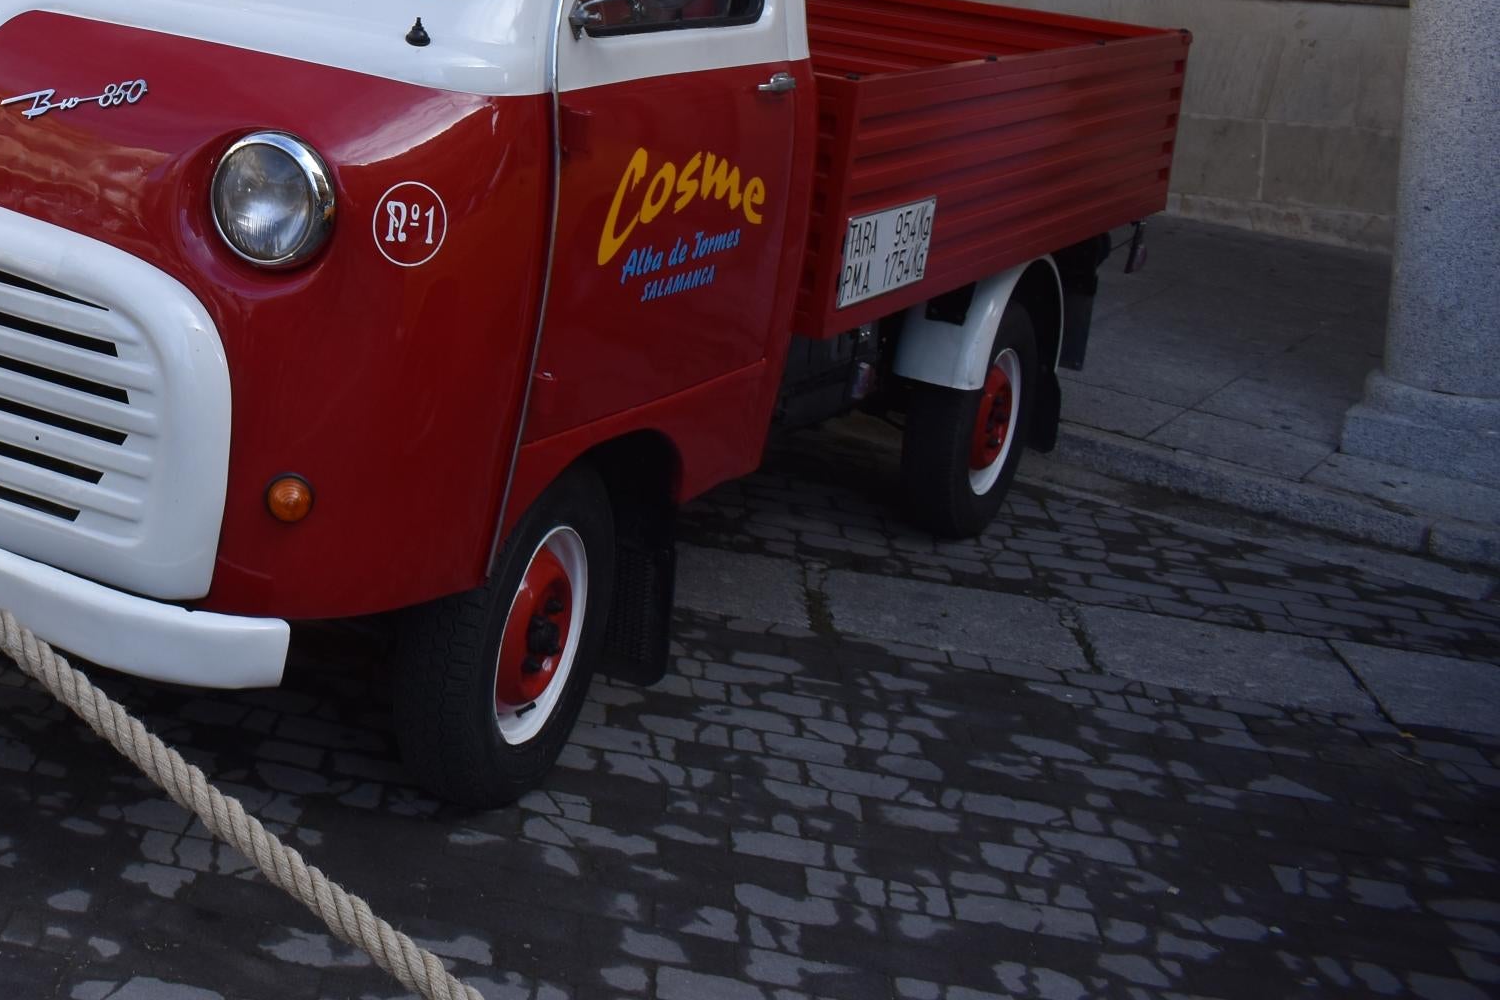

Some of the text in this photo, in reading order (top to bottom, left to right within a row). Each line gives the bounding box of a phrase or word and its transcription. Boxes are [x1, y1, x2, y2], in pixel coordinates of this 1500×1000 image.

[98, 79, 148, 107] 850
[598, 147, 765, 266] Cosme
[620, 228, 741, 285] Alba de Tormes
[850, 219, 878, 260] TARA
[640, 264, 715, 302] SALAMANCA
